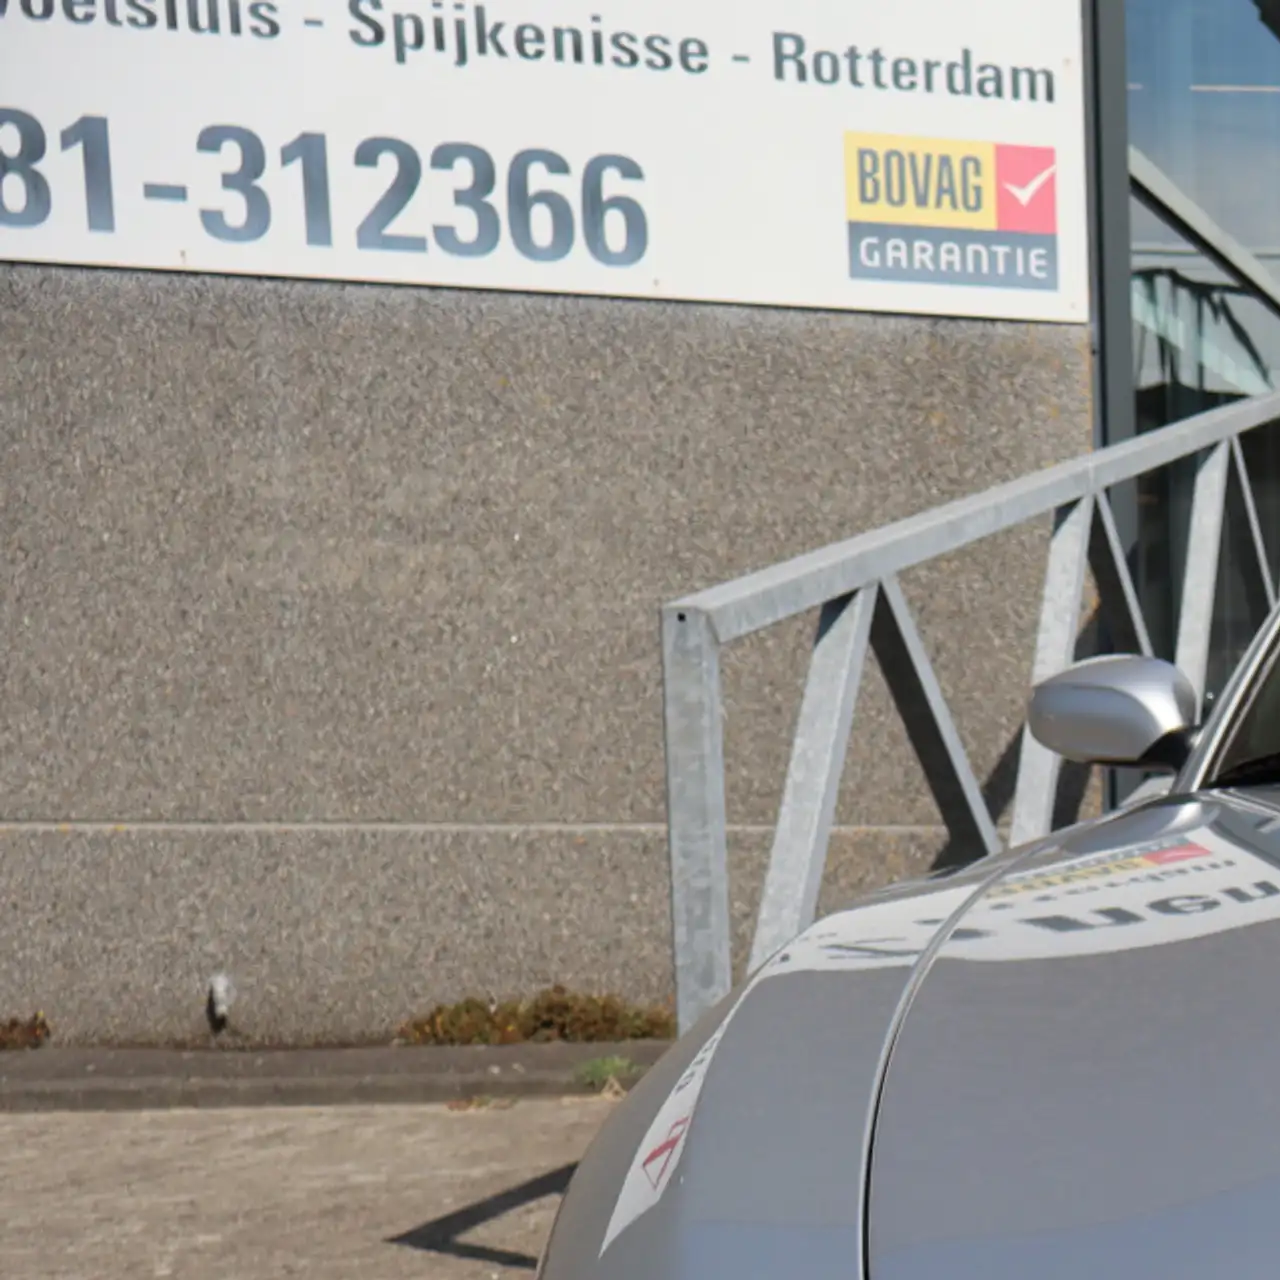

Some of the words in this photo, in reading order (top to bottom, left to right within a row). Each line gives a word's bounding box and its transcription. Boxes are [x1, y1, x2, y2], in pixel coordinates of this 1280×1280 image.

[0, 0, 280, 38] oetsluis
[348, 0, 709, 75] Spijkenisse
[771, 31, 1055, 103] Rotterdam
[0, 107, 649, 268] 81-312366
[857, 147, 983, 213] BOVAG
[859, 236, 1049, 279] GARANTIE
